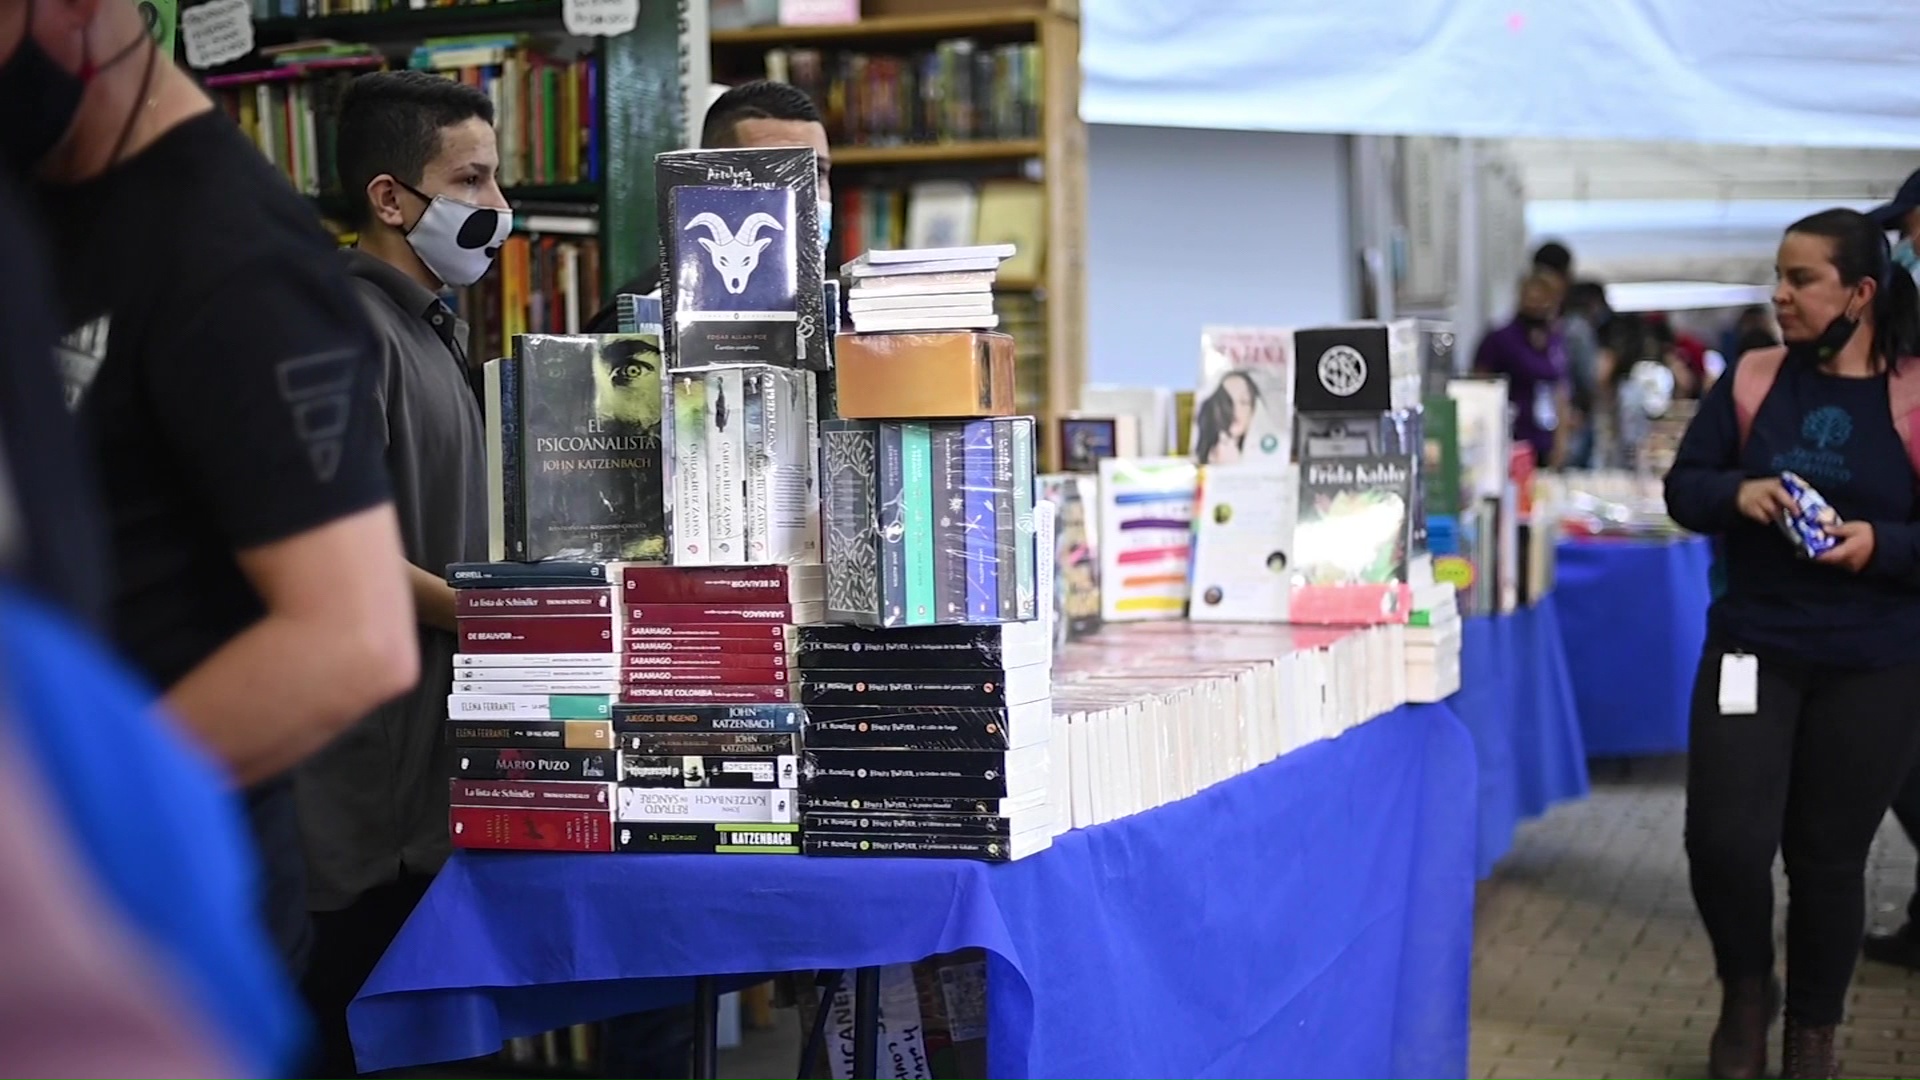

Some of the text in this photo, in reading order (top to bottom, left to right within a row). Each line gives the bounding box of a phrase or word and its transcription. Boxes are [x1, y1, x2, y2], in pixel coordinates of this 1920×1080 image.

[588, 419, 605, 433] EL
[537, 436, 656, 452] PSICOANALISTA
[543, 458, 652, 472] JOHN KATZENBACH
[1309, 462, 1406, 485] Frida Kahlo
[723, 480, 731, 502] RUIZ
[455, 571, 483, 579] ORWELL
[731, 579, 768, 588] BEAUVOIR
[769, 579, 780, 588] DE
[469, 599, 478, 607] La
[479, 598, 495, 606] lista
[495, 598, 505, 607] de
[505, 597, 538, 607] Schindler
[742, 610, 785, 619] SARAMAGO
[631, 627, 672, 635] SARAMAGO
[478, 632, 512, 640] BEAUVOIR
[631, 642, 673, 650] SARAMAGO
[823, 643, 849, 651] Rowling
[630, 657, 672, 665] SARAMAGO
[629, 672, 672, 680] SARAMAGO
[827, 683, 853, 691] Rowling
[630, 689, 662, 697] HISTORIA
[663, 689, 674, 697] DE
[674, 689, 713, 697] COLOMBIA
[461, 702, 516, 711] ELENA FERRANTE
[729, 707, 757, 718] JOHN
[624, 714, 698, 722] JUEGOS DE INGENIO
[712, 719, 775, 729] KATZENBACH
[829, 723, 856, 731] Rowling
[456, 728, 476, 738] ELENA
[477, 728, 510, 738] FERRANTE
[735, 735, 758, 744] JOHN
[720, 744, 774, 753] KATZENBACH
[496, 759, 570, 771] MARIO PUZO
[829, 769, 855, 777] Rowling
[465, 788, 475, 796] La
[475, 787, 491, 797] lista
[491, 788, 501, 797] de
[501, 788, 536, 798] Schindler
[640, 794, 679, 804] SANGRE
[695, 795, 767, 806] KATZENBACH
[822, 800, 848, 808] Rowling
[644, 805, 688, 814] RETRATO
[830, 818, 857, 827] Rowling
[731, 832, 792, 845] KATZENBACH
[830, 841, 857, 849] Rowling
